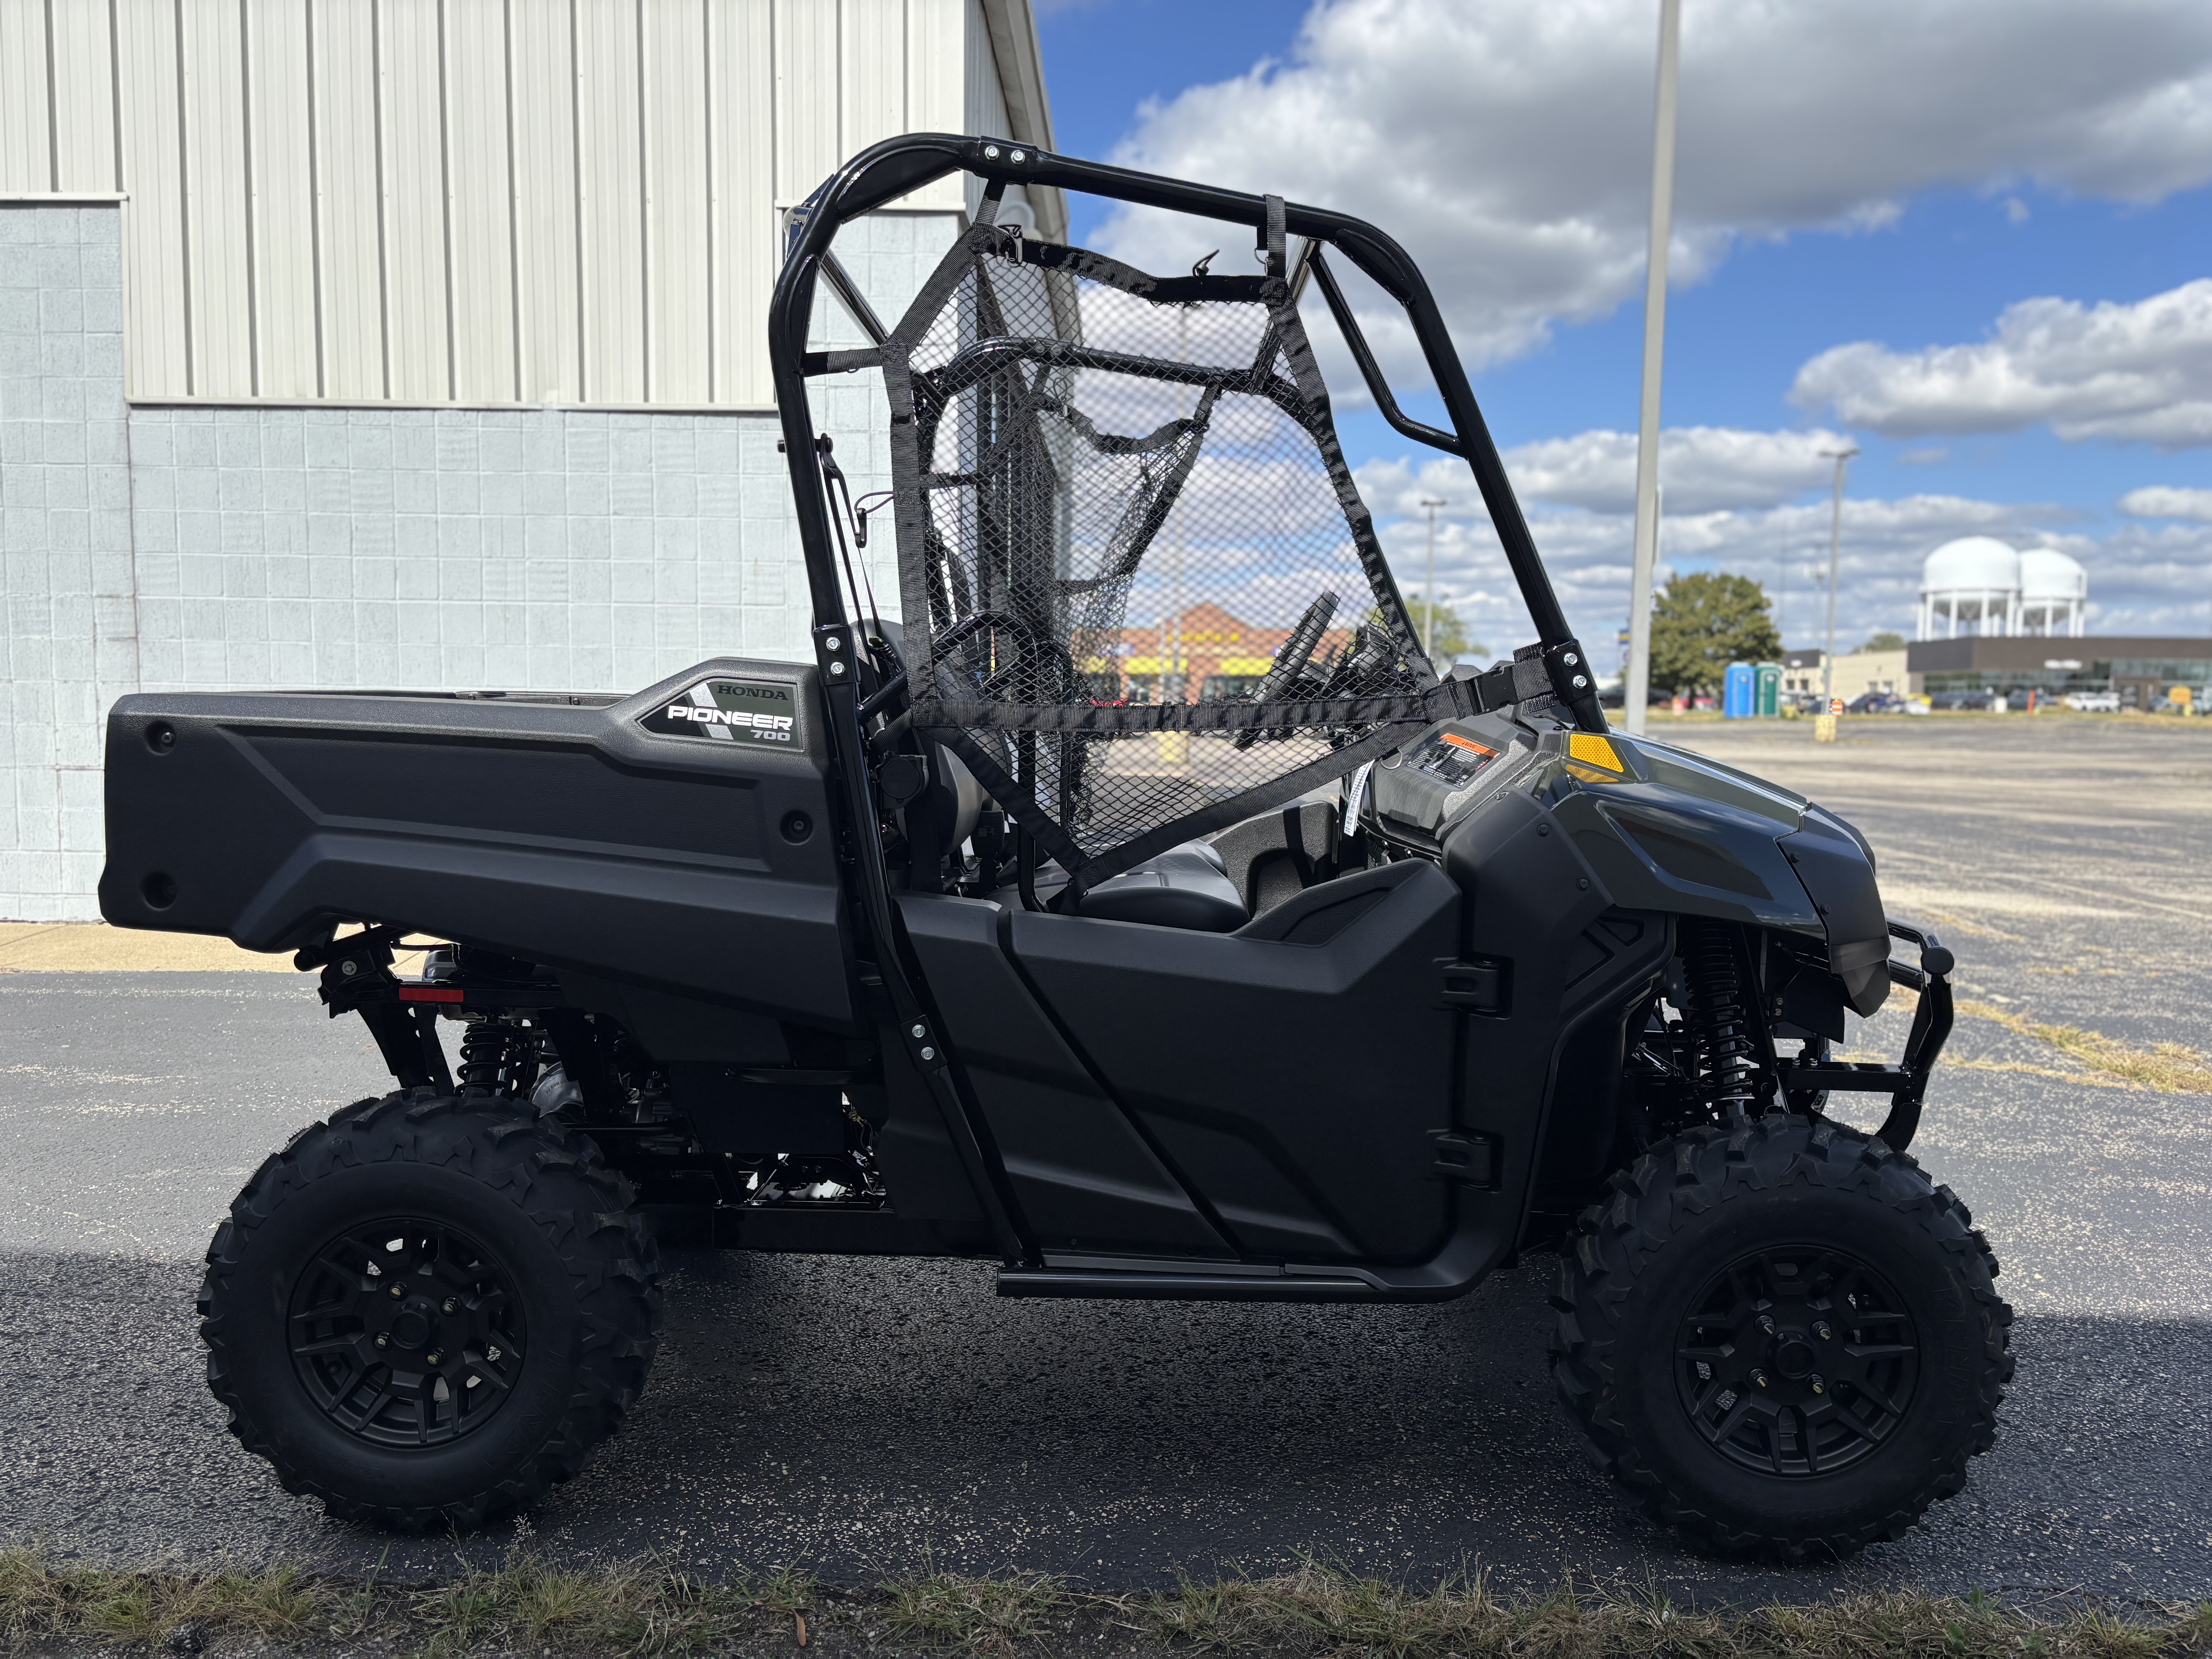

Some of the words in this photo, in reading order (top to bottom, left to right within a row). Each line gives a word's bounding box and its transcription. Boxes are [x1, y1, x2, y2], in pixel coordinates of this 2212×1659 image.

[718, 685, 789, 700] HONDA
[668, 705, 793, 730] PIONEER
[750, 730, 790, 741] 700
[1931, 1288, 1970, 1424] KENDA
